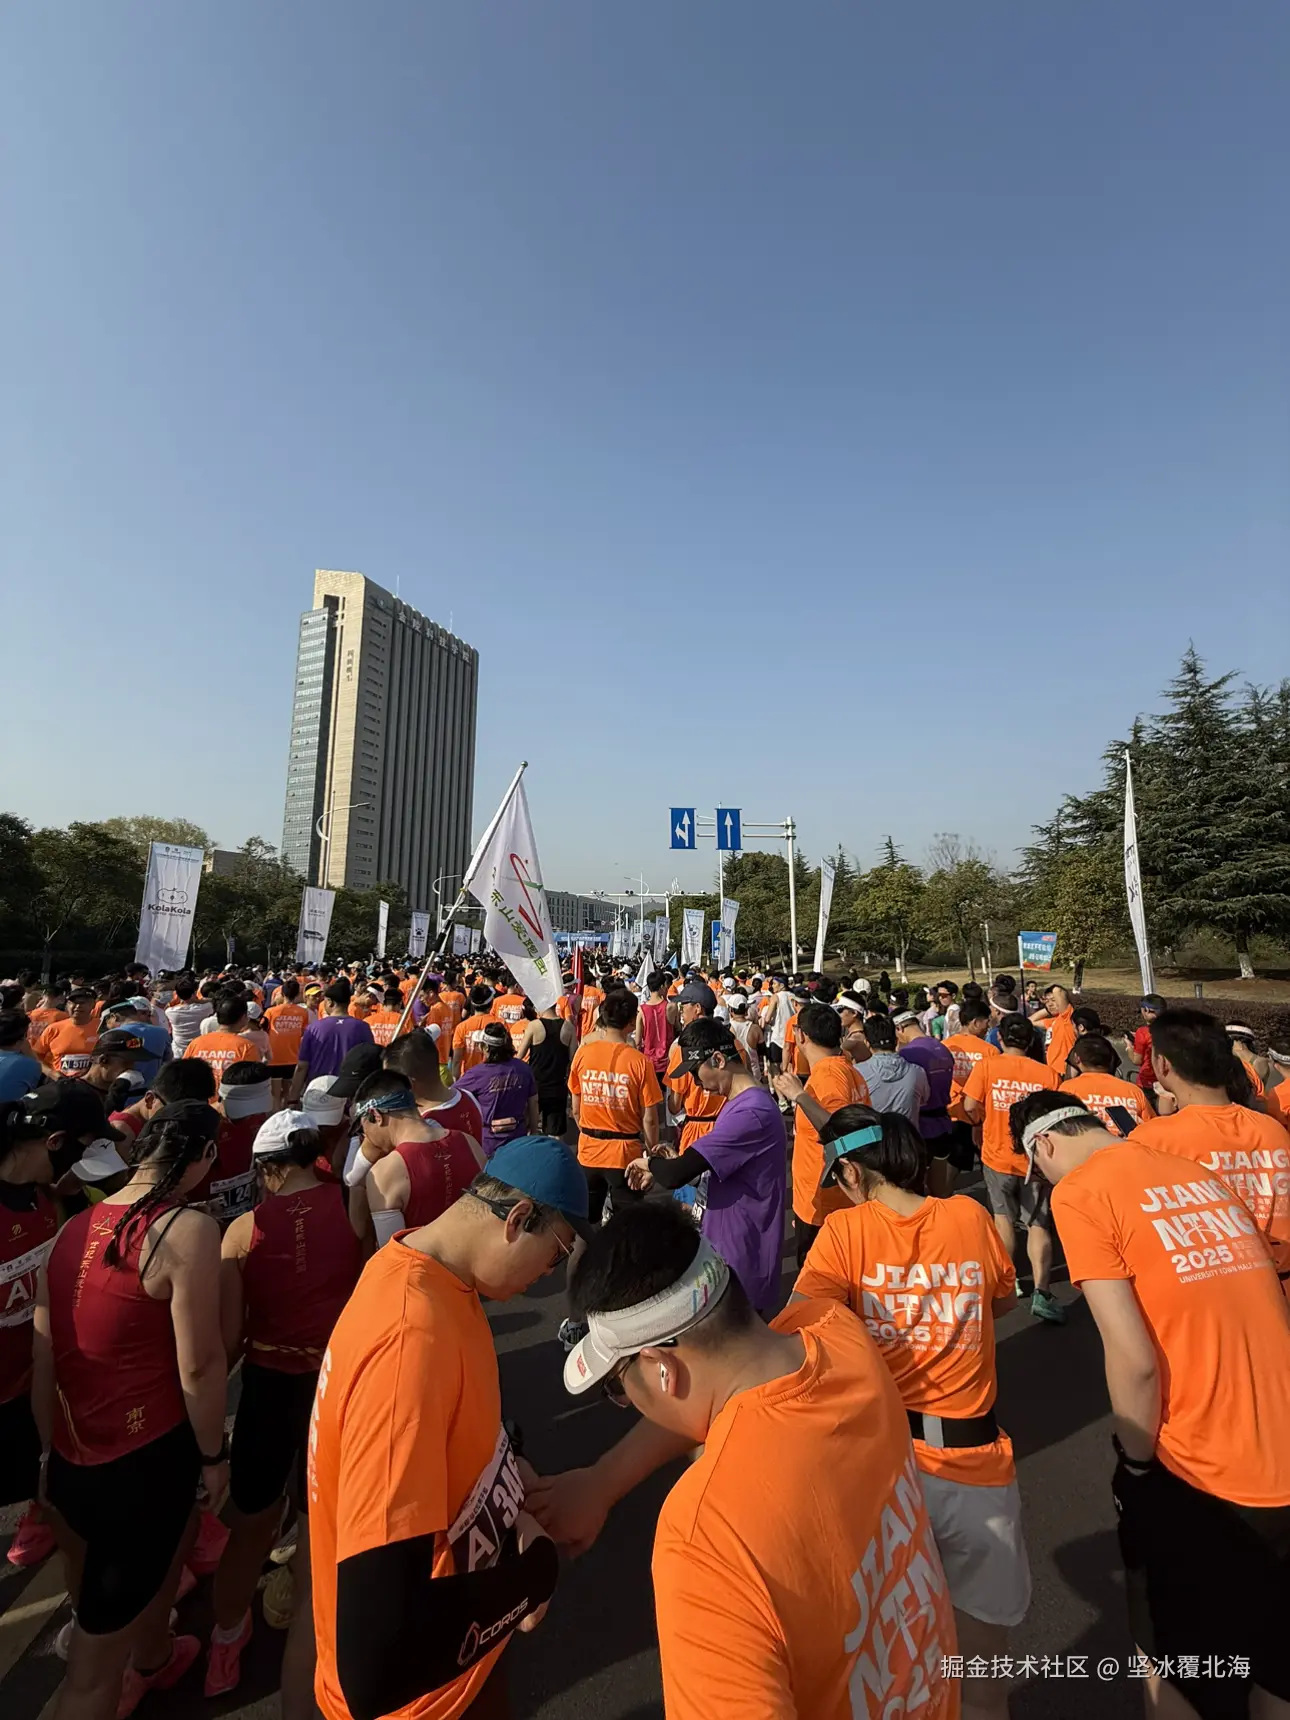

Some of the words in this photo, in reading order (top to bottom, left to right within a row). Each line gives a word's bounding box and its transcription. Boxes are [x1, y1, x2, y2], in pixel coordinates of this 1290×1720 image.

[148, 903, 191, 914] KolaKola
[196, 1051, 236, 1059] JIANG
[952, 1051, 983, 1060] IANG
[582, 1069, 629, 1084] JIANG
[992, 1079, 1043, 1092] JIANG
[1082, 1094, 1136, 1108] JIANG
[1200, 1149, 1289, 1170] JIANG
[1140, 1178, 1231, 1213] JIANG
[1171, 1244, 1234, 1273] 2025
[862, 1261, 983, 1289] JIANG
[1179, 1270, 1219, 1284] UNIVERSITY
[6, 1279, 30, 1309] A
[864, 1319, 931, 1342] 2025
[125, 1406, 145, 1435] 南京
[469, 1525, 496, 1572] A
[845, 1457, 922, 1653] JIAN
[479, 1598, 528, 1645] COROS
